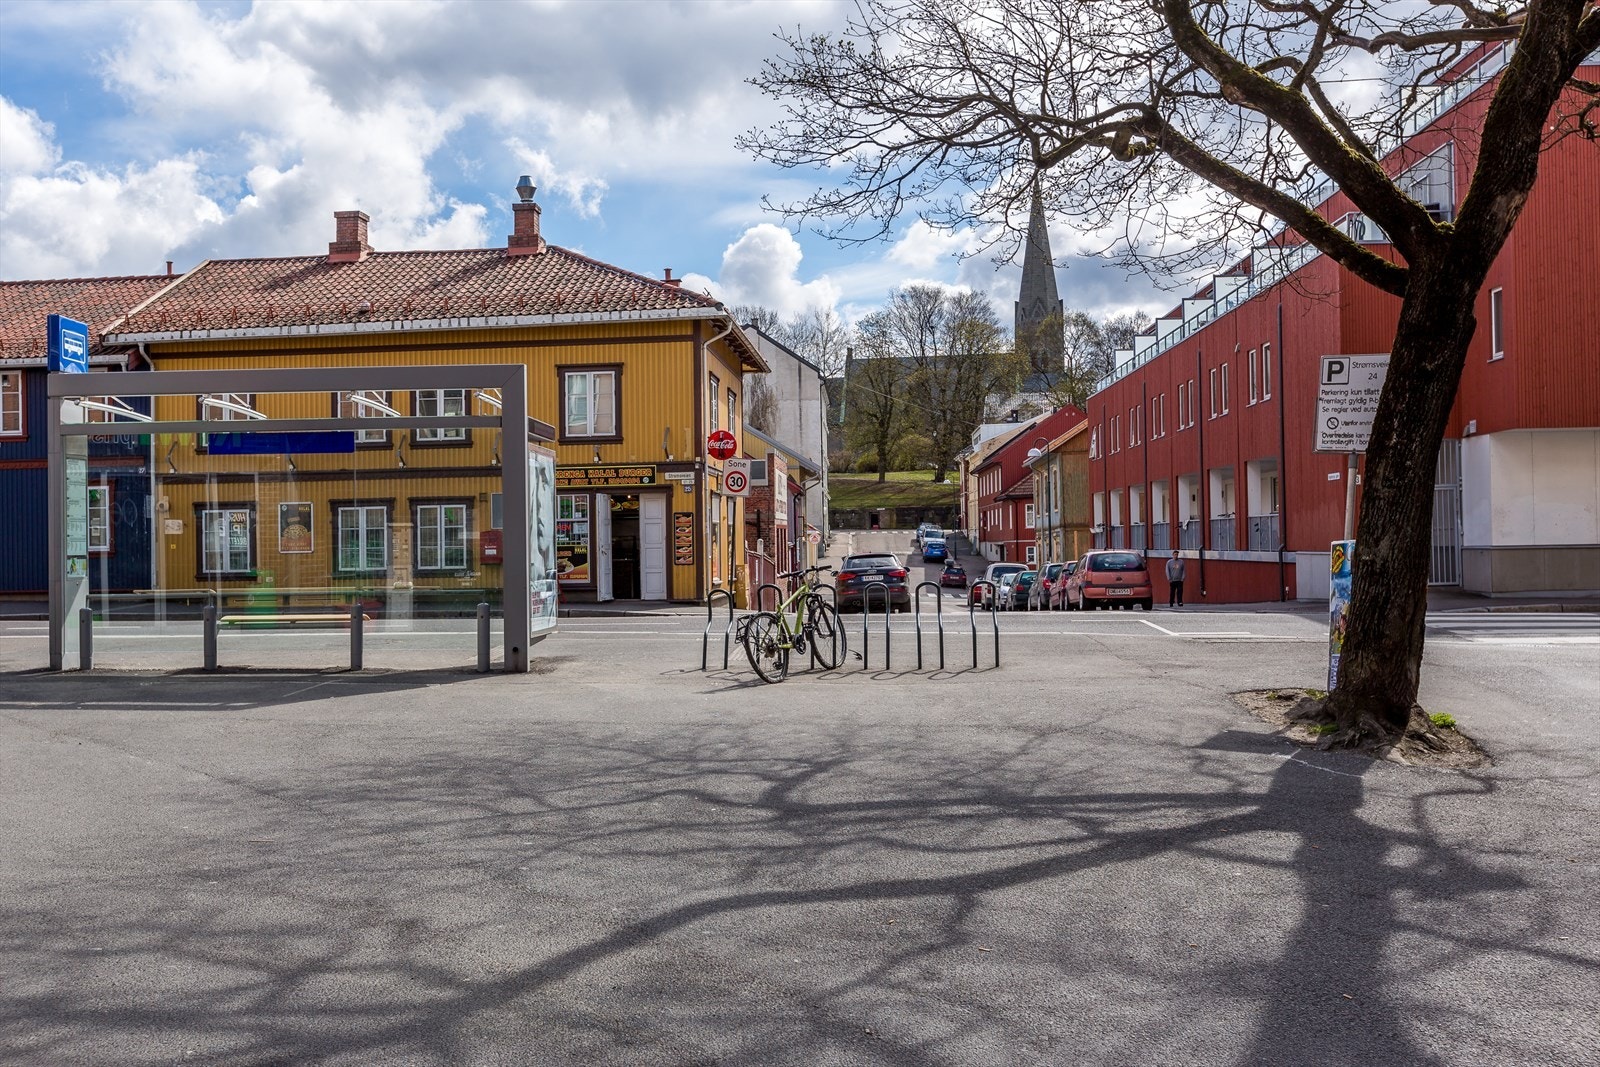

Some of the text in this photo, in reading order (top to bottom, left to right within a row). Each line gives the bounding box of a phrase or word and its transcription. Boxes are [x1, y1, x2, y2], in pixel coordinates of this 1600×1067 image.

[1327, 361, 1344, 382] P
[1368, 372, 1377, 380] 24
[1349, 397, 1366, 405] gyldig
[728, 460, 747, 468] Sone
[556, 468, 652, 478] RENGA HALAL BURGER
[730, 476, 743, 487] 30
